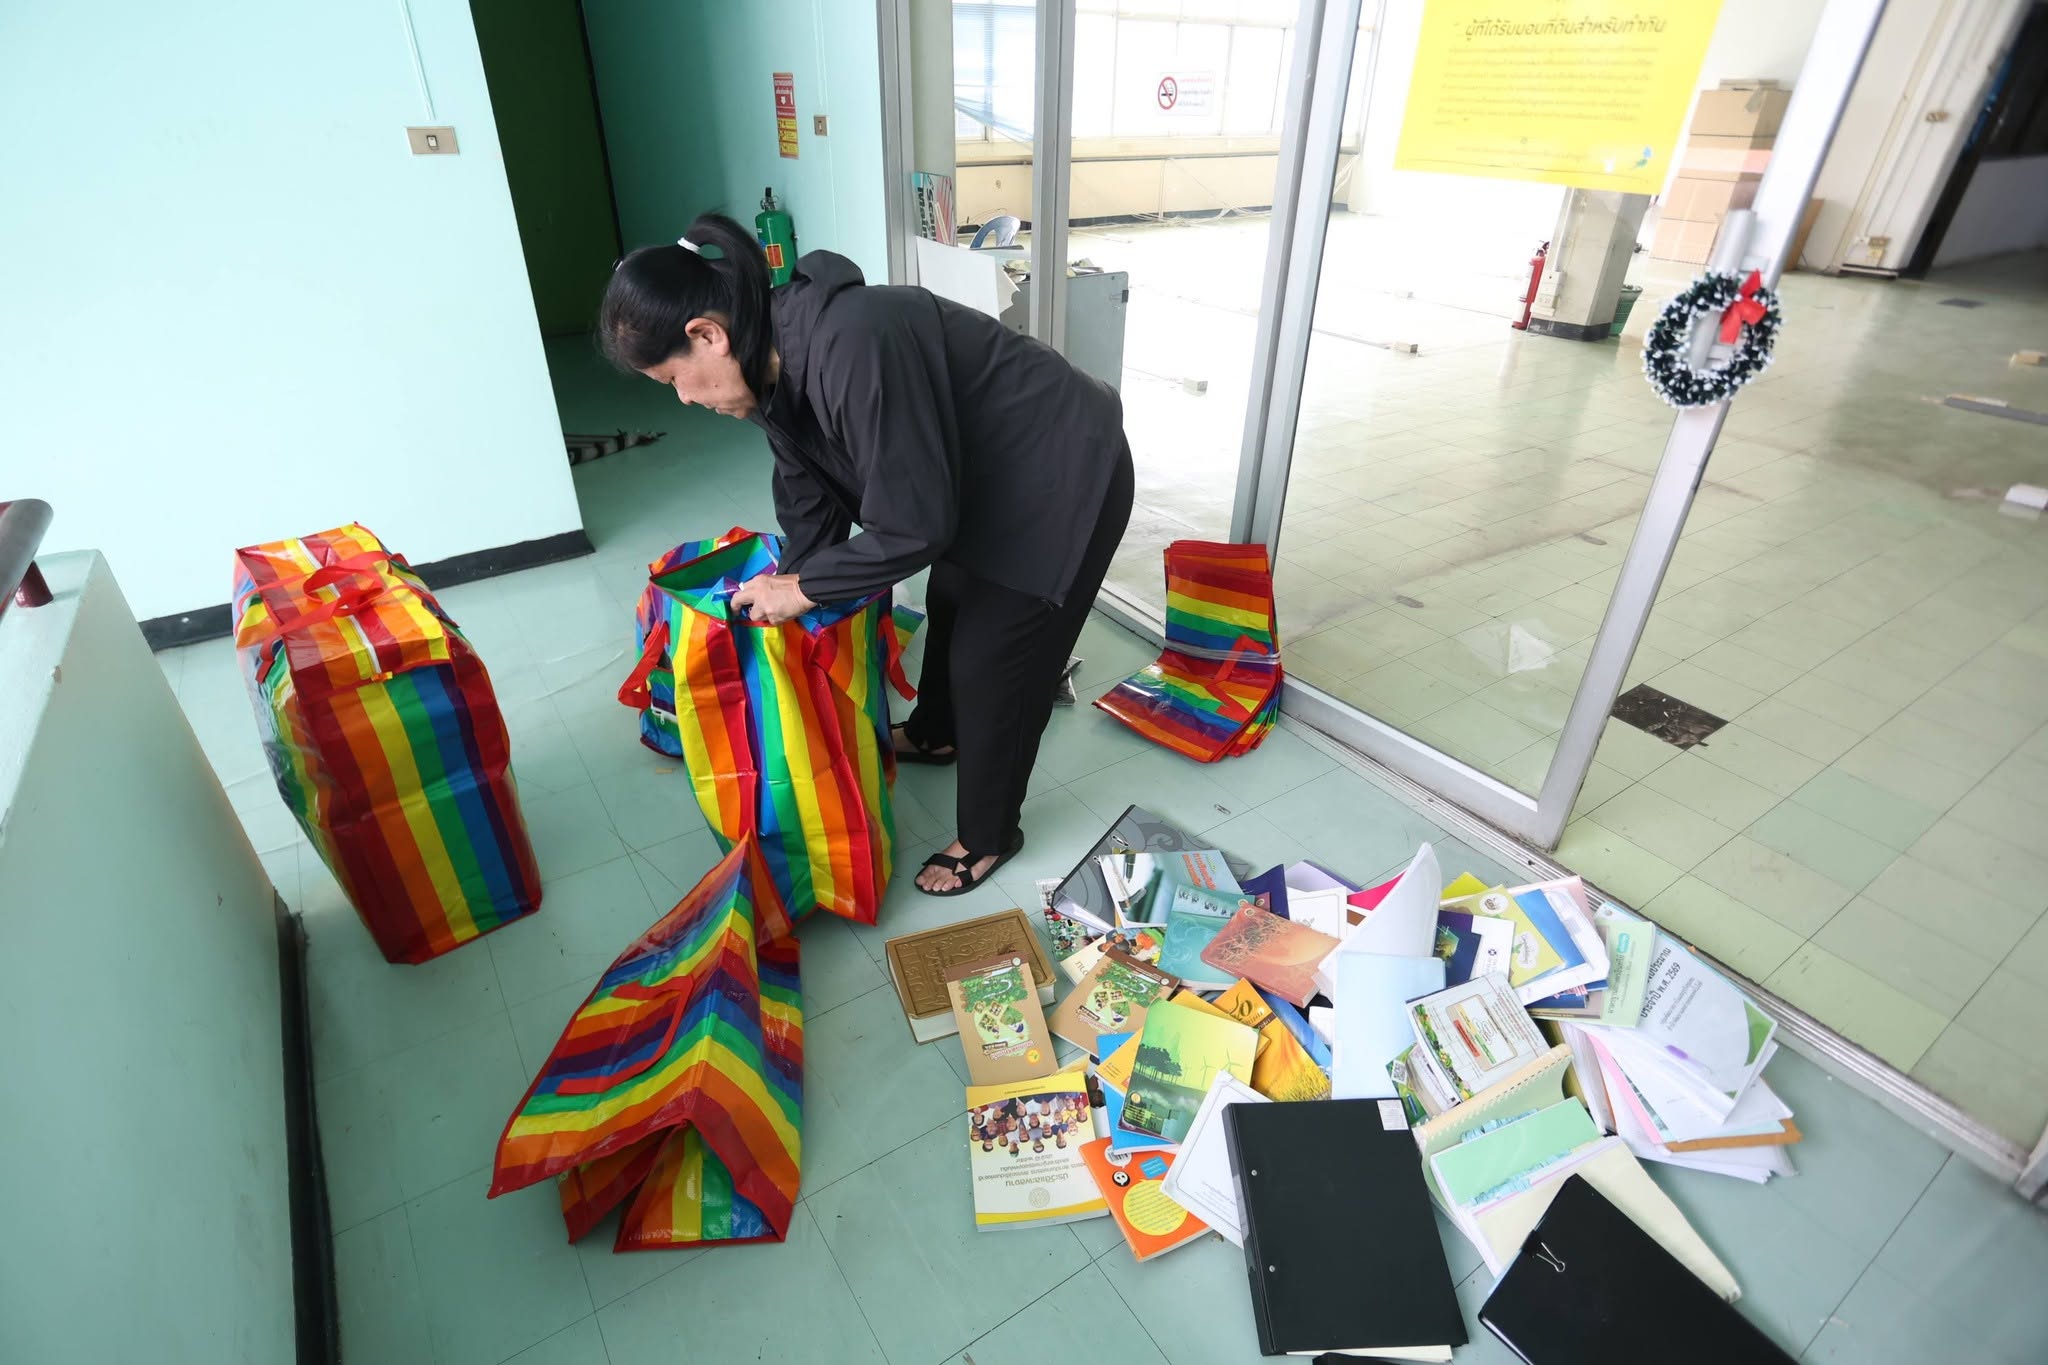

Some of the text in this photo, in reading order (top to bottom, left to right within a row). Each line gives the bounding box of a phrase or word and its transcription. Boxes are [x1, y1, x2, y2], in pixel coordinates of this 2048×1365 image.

[1665, 962, 1681, 981] 2569
[1005, 1173, 1069, 1187] ประวัติและผลงาน
